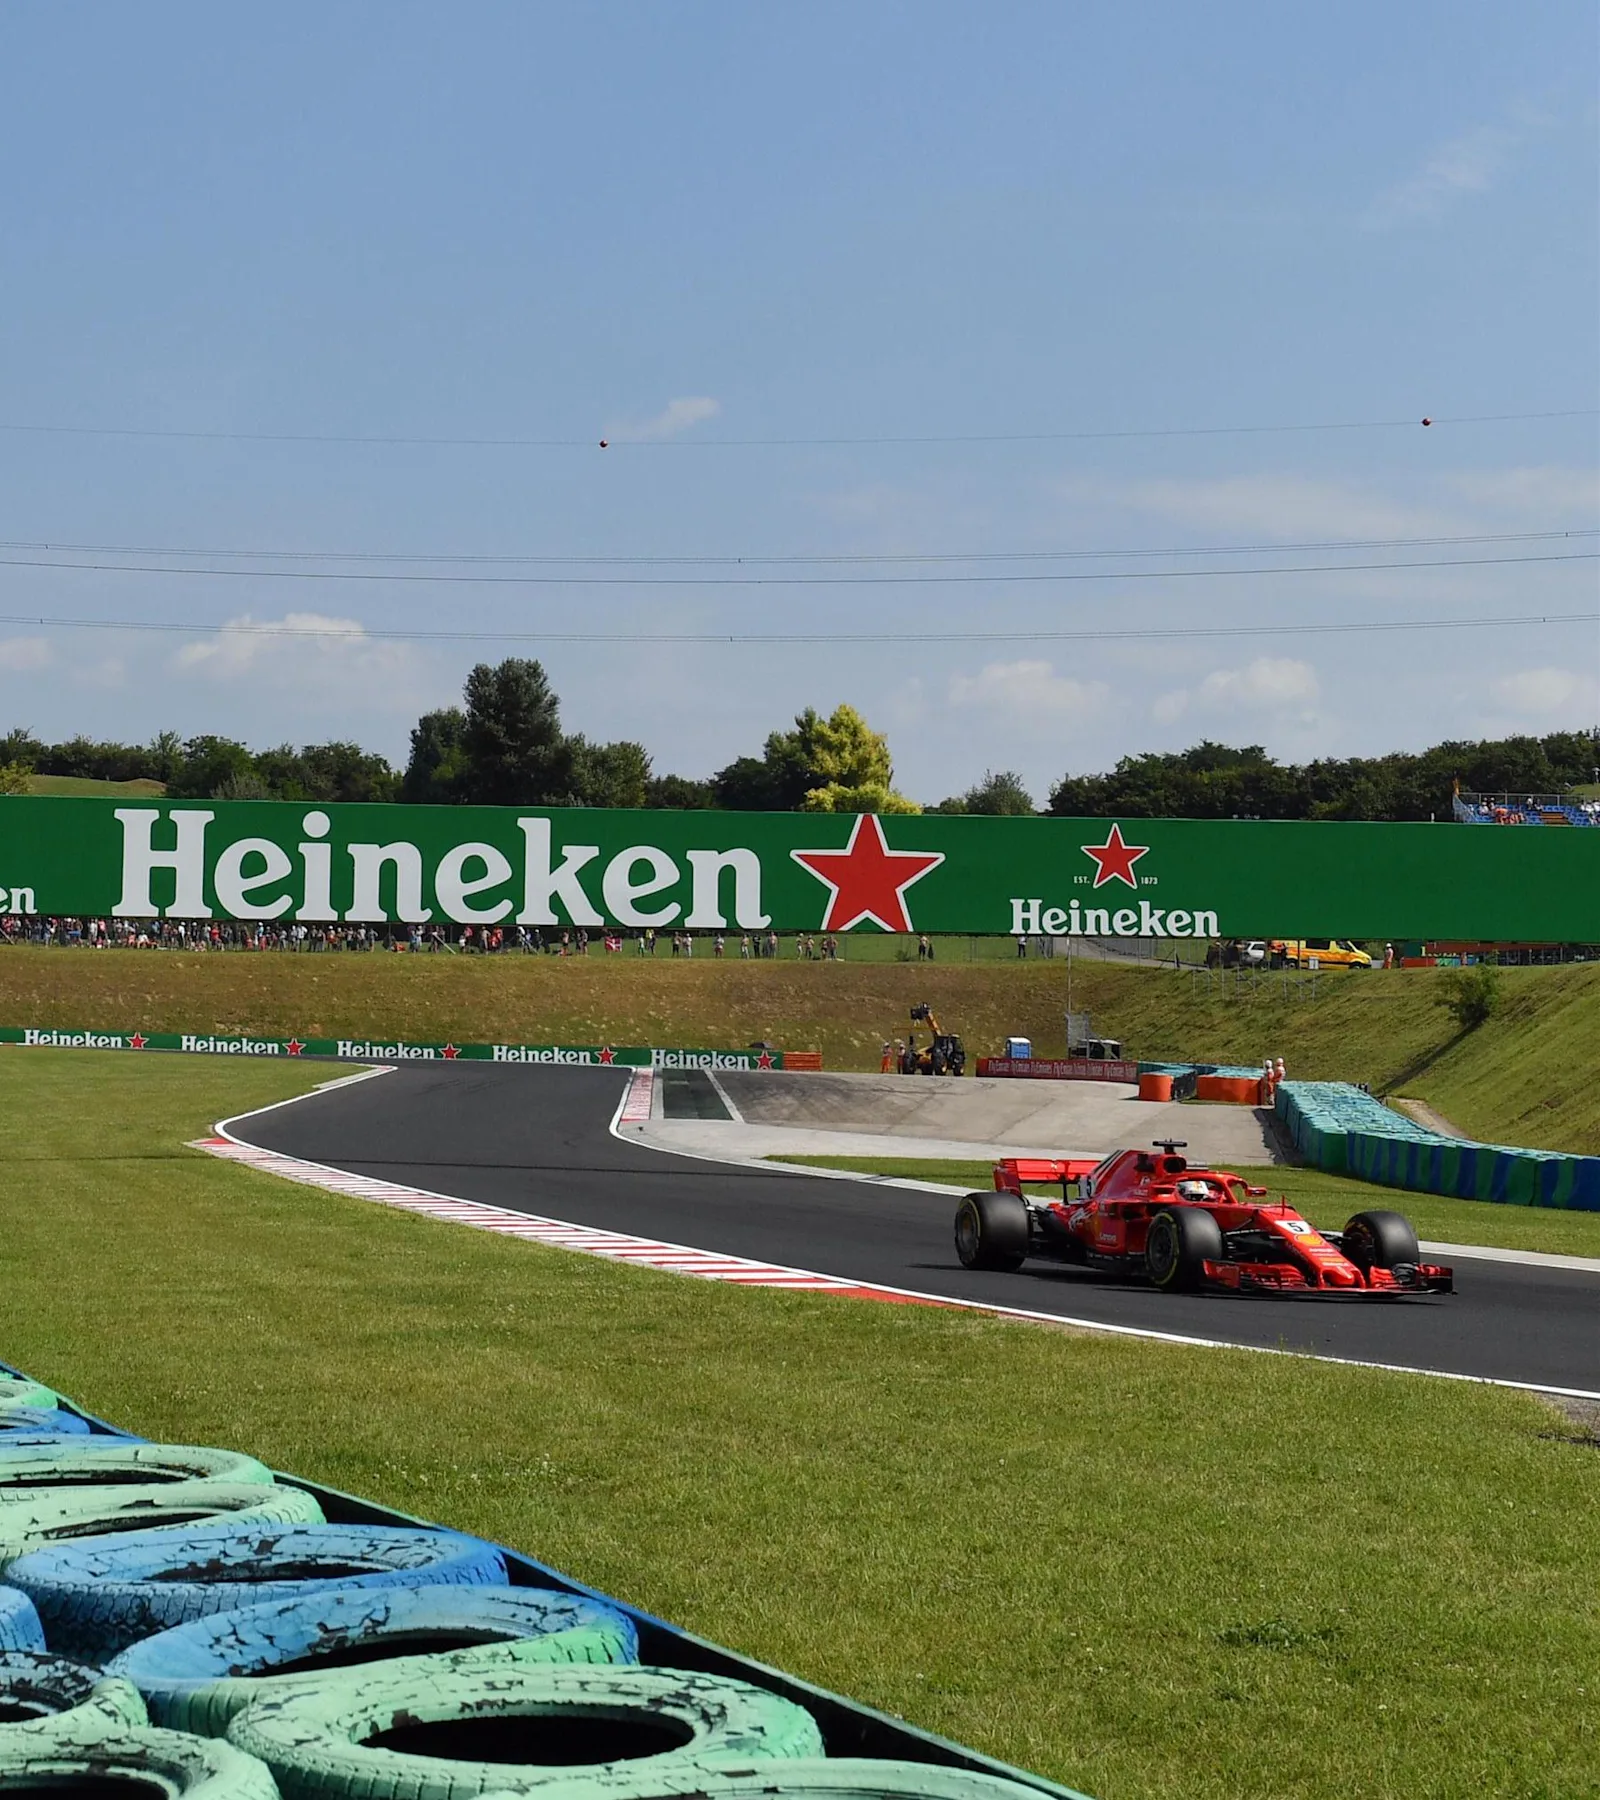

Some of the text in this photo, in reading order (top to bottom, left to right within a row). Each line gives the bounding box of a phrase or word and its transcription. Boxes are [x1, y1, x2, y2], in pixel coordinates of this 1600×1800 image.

[112, 808, 772, 928] Heineken
[1074, 876, 1090, 884] EST.
[1009, 899, 1221, 937] Heineken
[24, 1029, 122, 1048] Heineken
[181, 1035, 279, 1055] Heineken
[337, 1041, 435, 1060] Heineken
[492, 1045, 591, 1064] Heineken
[651, 1049, 750, 1070] Heineken
[1288, 1222, 1304, 1232] 5
